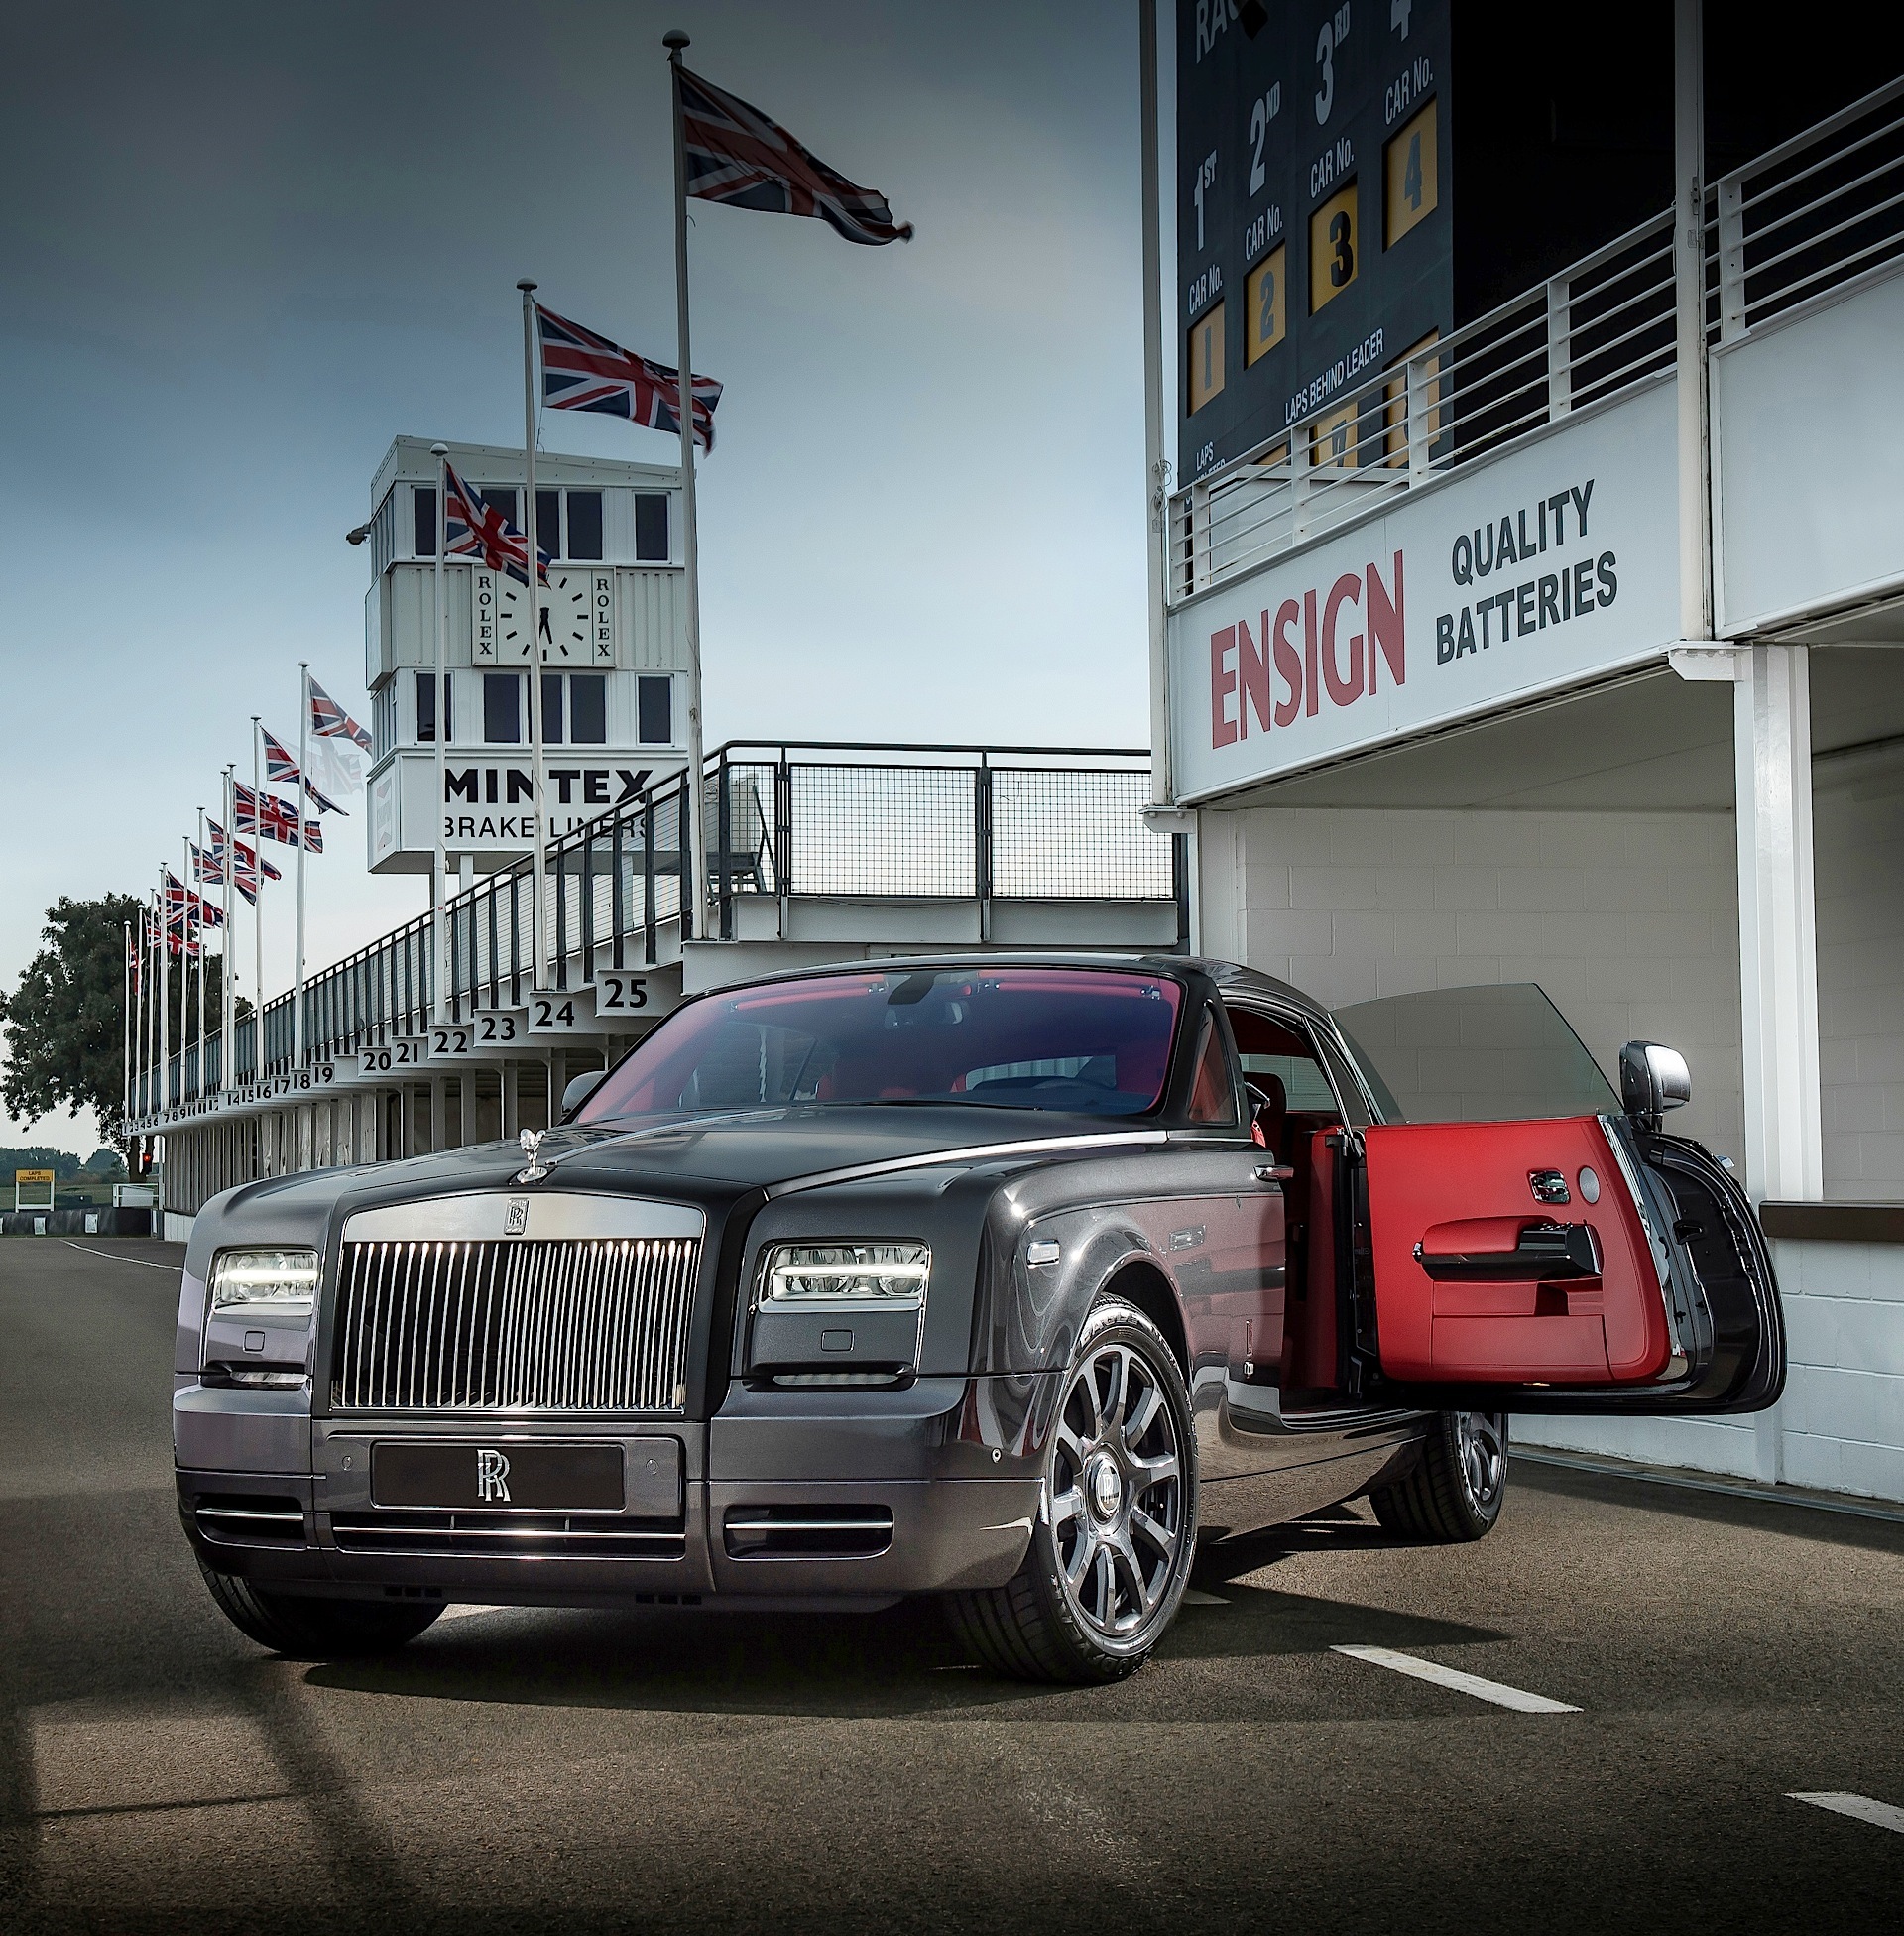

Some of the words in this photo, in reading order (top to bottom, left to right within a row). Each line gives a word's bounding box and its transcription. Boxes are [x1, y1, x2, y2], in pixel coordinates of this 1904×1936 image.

[1196, 0, 1239, 64] RA
[1315, 0, 1350, 125] 3RD
[1385, 69, 1409, 126] CAR
[1413, 56, 1434, 97] No.
[1249, 80, 1281, 198] 2ND
[1310, 149, 1333, 199] CAR
[1337, 137, 1355, 175] No.
[1404, 130, 1422, 213] 4
[1194, 149, 1217, 251] 1ST
[1246, 215, 1264, 261] CAR
[1267, 204, 1283, 240] No.
[1329, 210, 1354, 287] 3
[1189, 273, 1206, 315] CAR
[1209, 263, 1223, 298] No.
[1259, 270, 1276, 344] 2
[1204, 327, 1213, 391] 1
[1285, 388, 1308, 425] LAPS
[1310, 360, 1345, 407] BEHIND
[1346, 327, 1383, 379] LEADER
[1196, 441, 1214, 471] LAPS
[1452, 478, 1595, 587] QUALITY
[478, 576, 493, 655] ROLEX
[596, 578, 611, 657] ROLEX
[1436, 550, 1617, 666] BATTERIES
[1211, 549, 1405, 750] ENSIGN
[444, 768, 654, 804] MINTEX
[535, 1001, 574, 1027] 24
[605, 978, 648, 1008] 25
[434, 1031, 468, 1052] 22
[481, 1017, 516, 1040] 23
[314, 1066, 333, 1083] 19
[363, 1052, 391, 1071] 20
[396, 1043, 418, 1062] 21
[227, 1093, 239, 1106] 14
[241, 1089, 253, 1102] 15
[257, 1084, 271, 1098] 16
[275, 1079, 290, 1094] 17
[294, 1073, 310, 1089] 18
[147, 1119, 151, 1128] 5
[164, 1114, 169, 1123] 7
[172, 1112, 178, 1121] 8
[180, 1109, 185, 1119] 9
